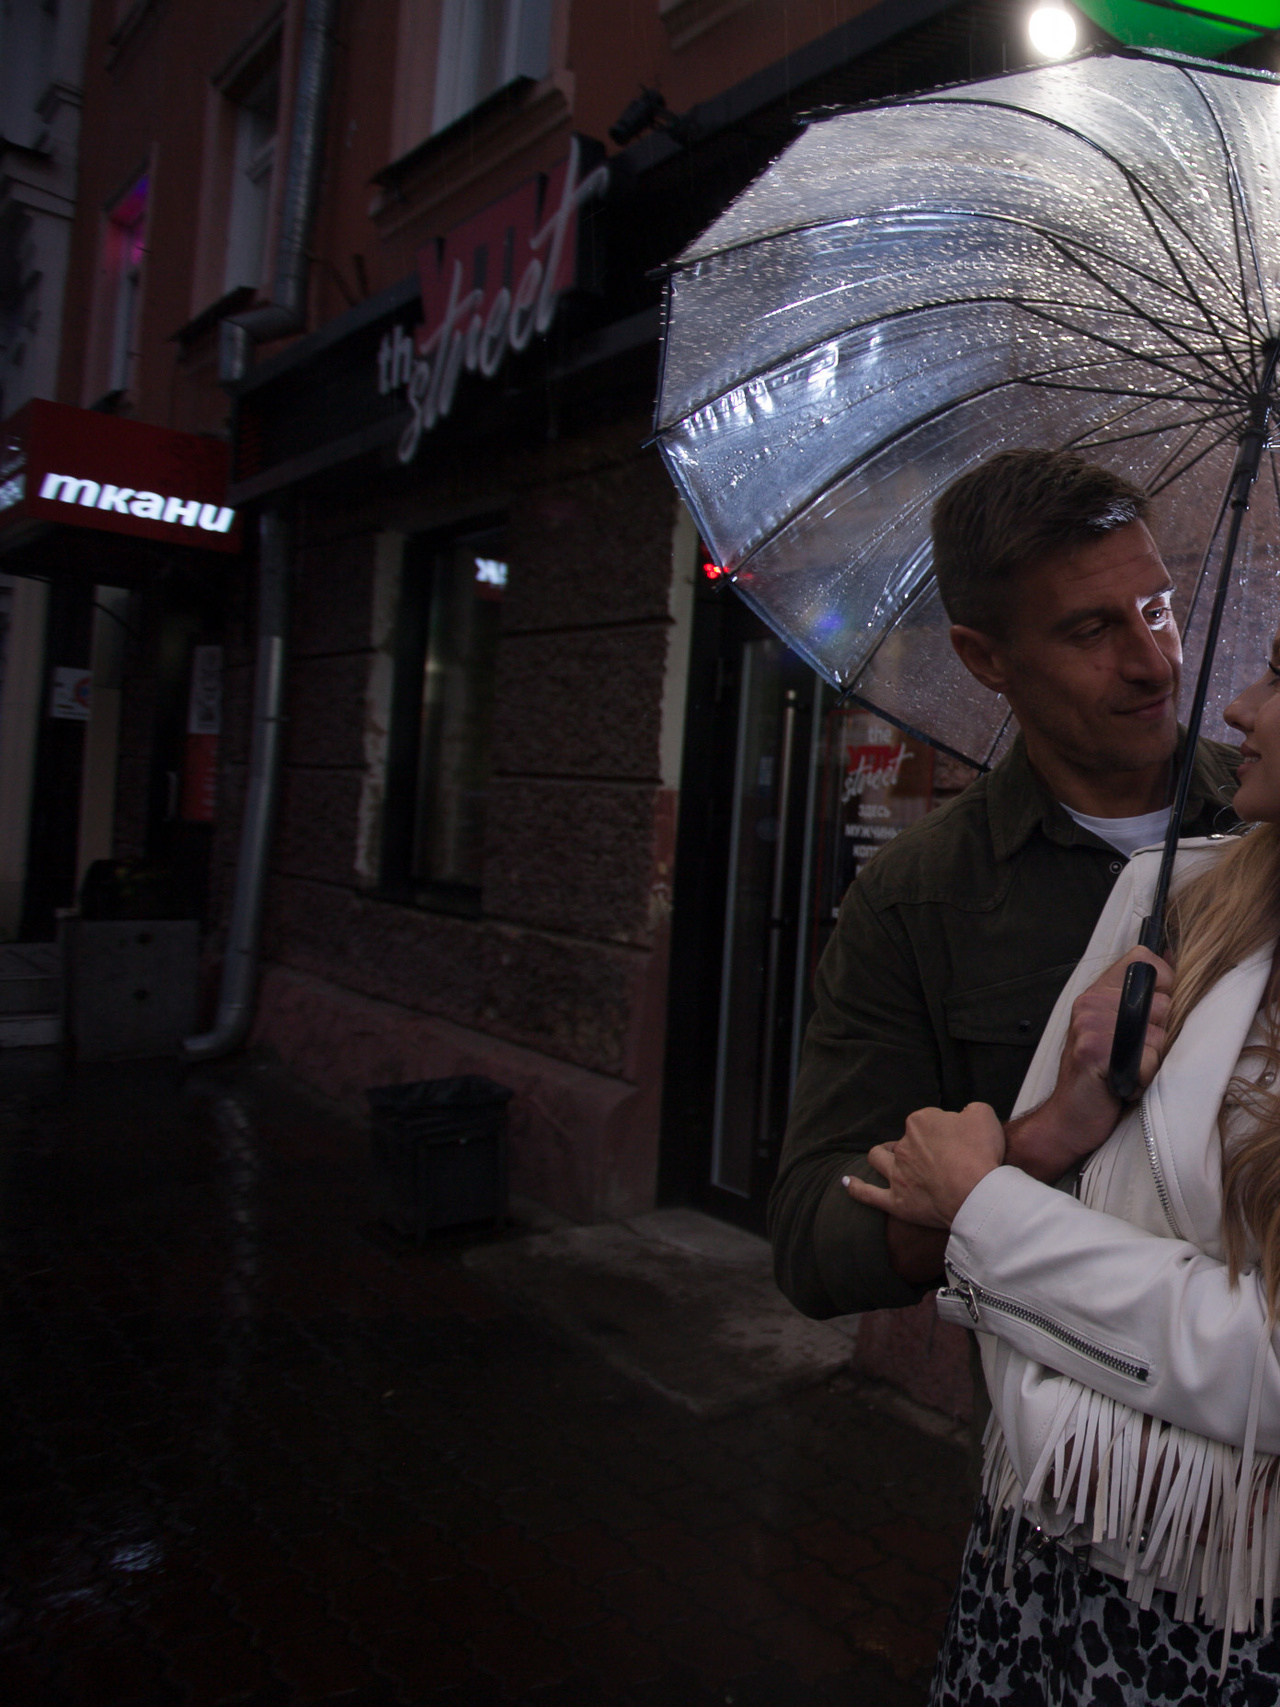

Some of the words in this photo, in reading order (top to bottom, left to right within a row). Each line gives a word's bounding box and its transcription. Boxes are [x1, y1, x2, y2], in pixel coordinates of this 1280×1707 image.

[39, 472, 236, 533] ткани
[868, 725, 892, 744] the
[841, 742, 915, 804] street
